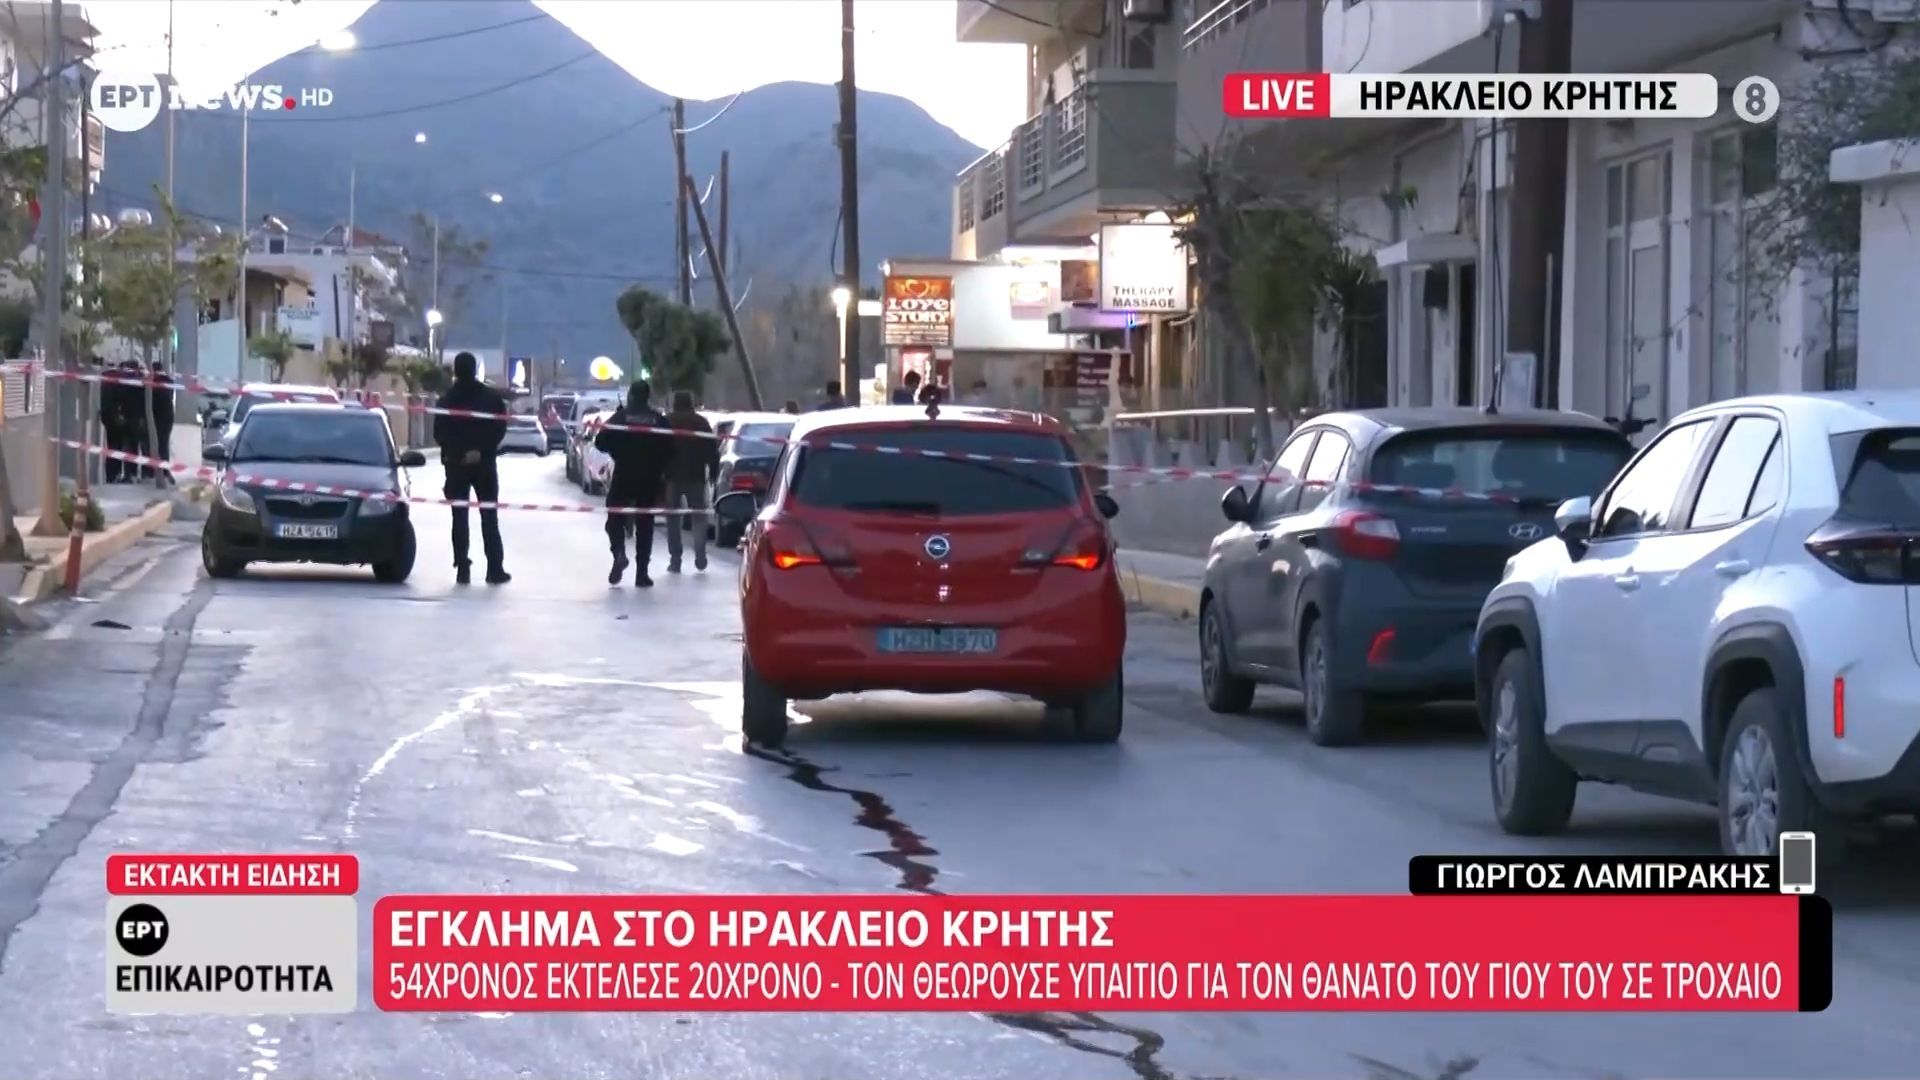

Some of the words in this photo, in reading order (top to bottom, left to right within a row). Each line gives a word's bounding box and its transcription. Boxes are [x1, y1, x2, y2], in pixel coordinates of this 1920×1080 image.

[1113, 285, 1175, 296] THERAPY
[1112, 297, 1177, 308] MASSAGE
[886, 311, 951, 323] STORY
